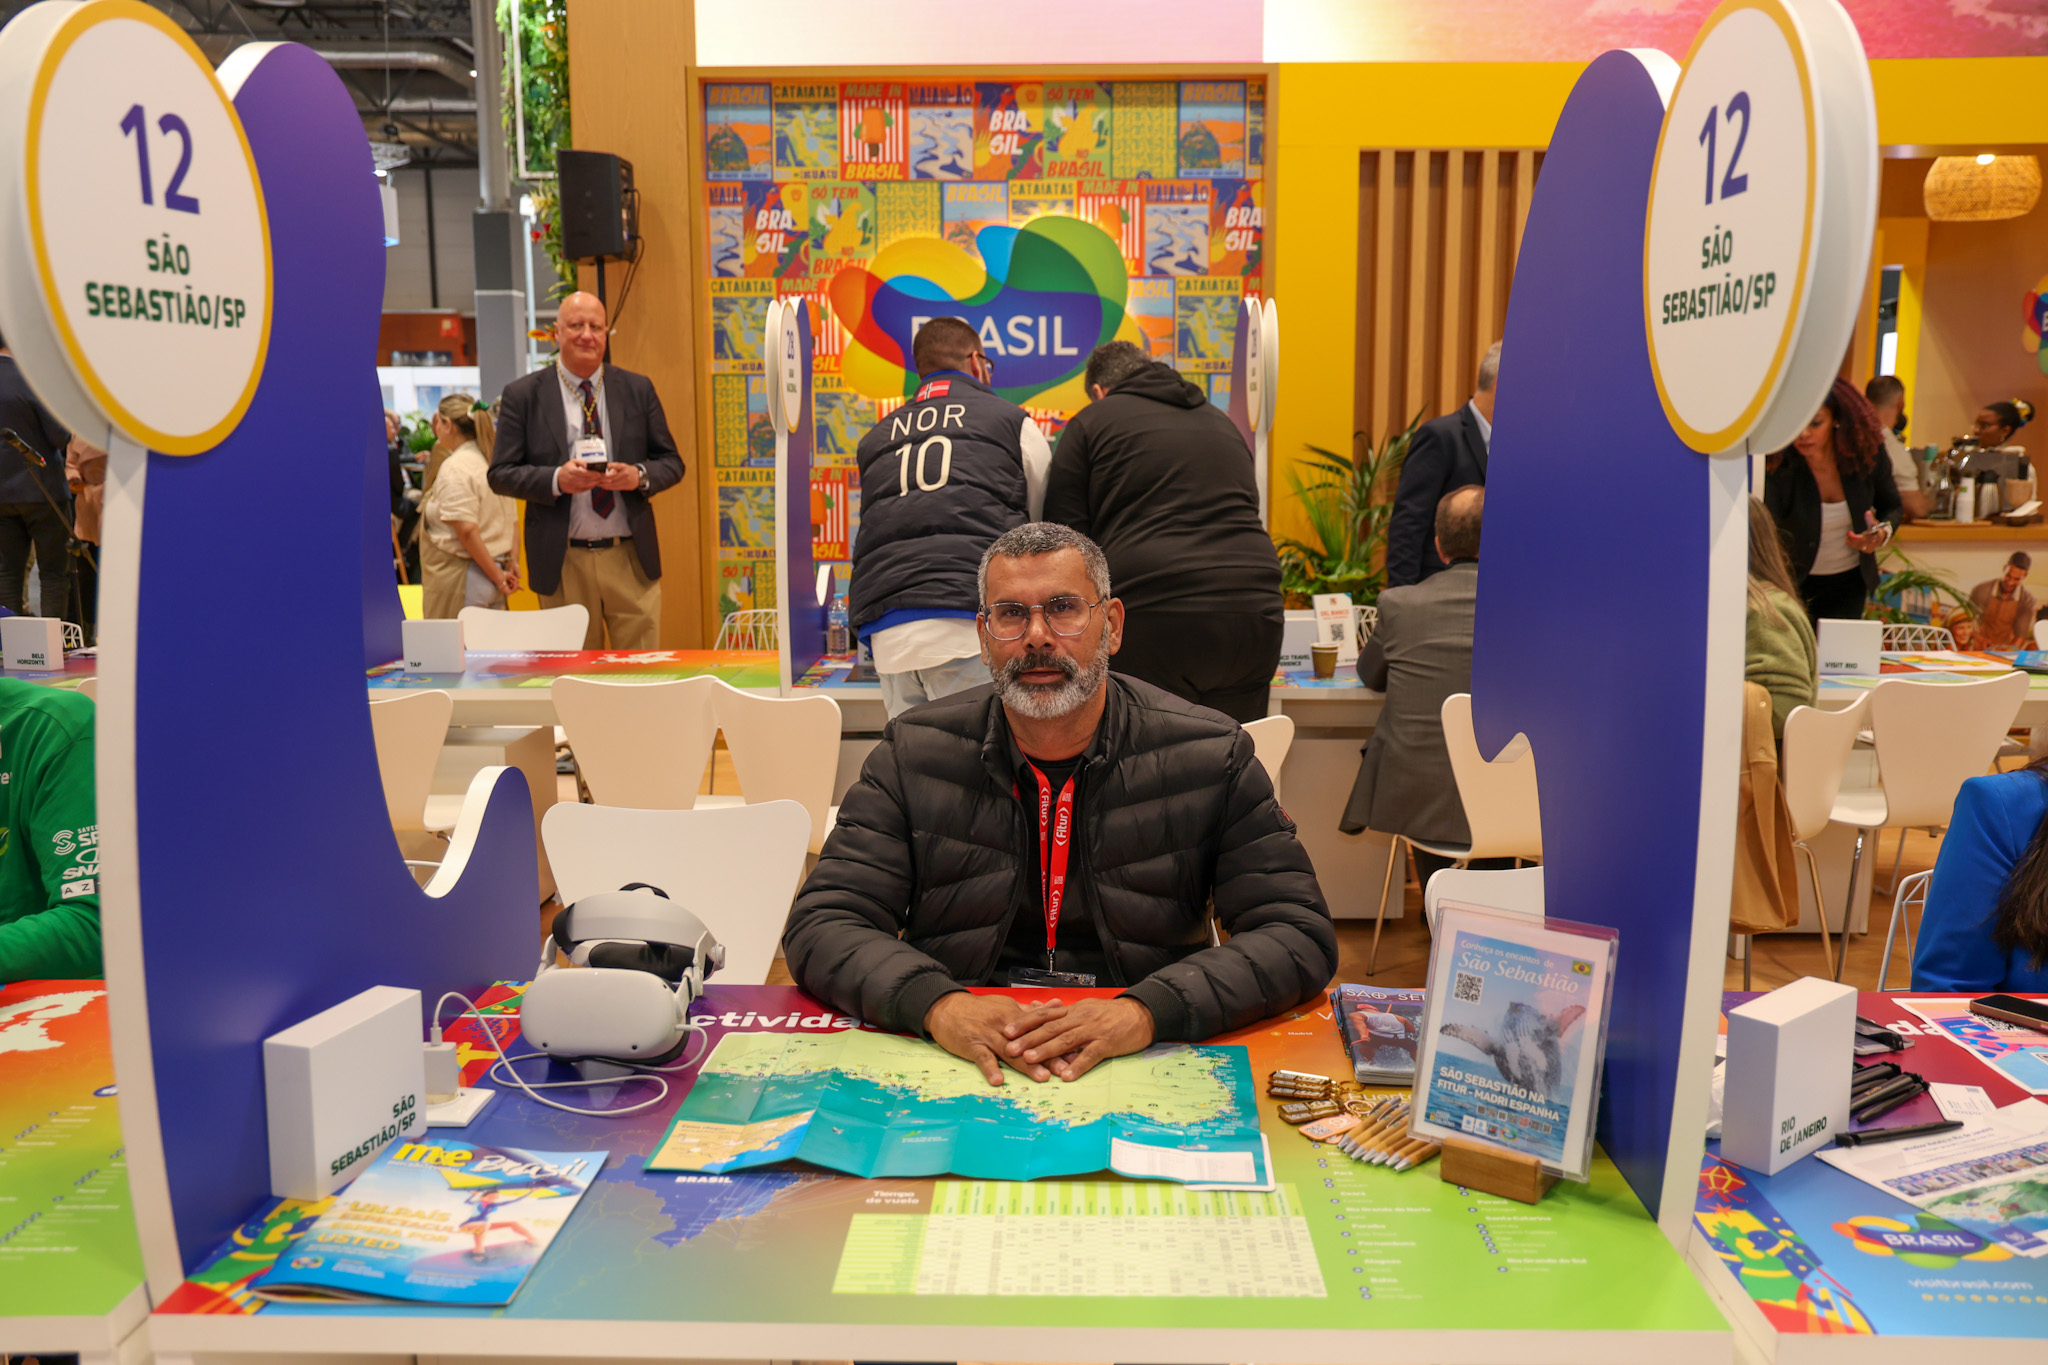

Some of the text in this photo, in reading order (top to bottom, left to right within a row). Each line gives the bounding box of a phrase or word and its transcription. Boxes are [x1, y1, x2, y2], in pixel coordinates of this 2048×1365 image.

[709, 86, 769, 105] BRASIL
[845, 84, 902, 98] MADE IN
[1047, 86, 1096, 101] SÓ TEM
[1182, 83, 1244, 103] BRASIL
[989, 110, 1027, 132] BRA
[990, 134, 1024, 155] SIL
[1699, 91, 1751, 206] 12
[120, 103, 201, 215] 12
[1047, 161, 1106, 178] BRASIL
[845, 163, 903, 180] BRASIL
[811, 185, 859, 199] SÓ TEM
[945, 184, 1005, 203] BRASIL
[1081, 181, 1139, 194] MADE IN
[756, 209, 793, 230] BRA
[756, 232, 789, 253] SIL
[1225, 230, 1258, 251] SIL
[1701, 225, 1733, 269] SÃO
[146, 232, 190, 276] SÃO
[781, 278, 819, 292] MADE
[85, 282, 246, 330] SEBASTIÃO/SP
[1662, 271, 1777, 325] SEBASTIÃO/SP
[911, 314, 1079, 356] ASIL
[891, 403, 966, 441] NOR
[895, 435, 953, 498] 10
[1056, 813, 1068, 838] Fitur
[1461, 939, 1555, 968] Conheça os encantos de
[1458, 951, 1579, 994] São Sebastião
[1346, 988, 1387, 1000] SÃO
[1439, 1065, 1546, 1106] SÃO SEBASTIÃO NA
[392, 1094, 416, 1118] SÃO
[1437, 1078, 1467, 1096] FITUR
[1474, 1088, 1508, 1108] MADRI
[1509, 1099, 1560, 1122] ESPANHA
[1779, 1116, 1828, 1154] DE JANEIRO
[1781, 1115, 1796, 1136] RIO
[331, 1112, 416, 1176] SEBASTIÃO/SP
[469, 1155, 590, 1179] Brasil
[675, 1176, 733, 1184] BRASIL
[873, 1190, 915, 1198] Tiempo
[350, 1201, 451, 1221] UN PAÍS
[317, 1233, 401, 1250] USTED
[329, 1222, 449, 1242] ESPERA POR
[1882, 1233, 1976, 1248] BRASIL
